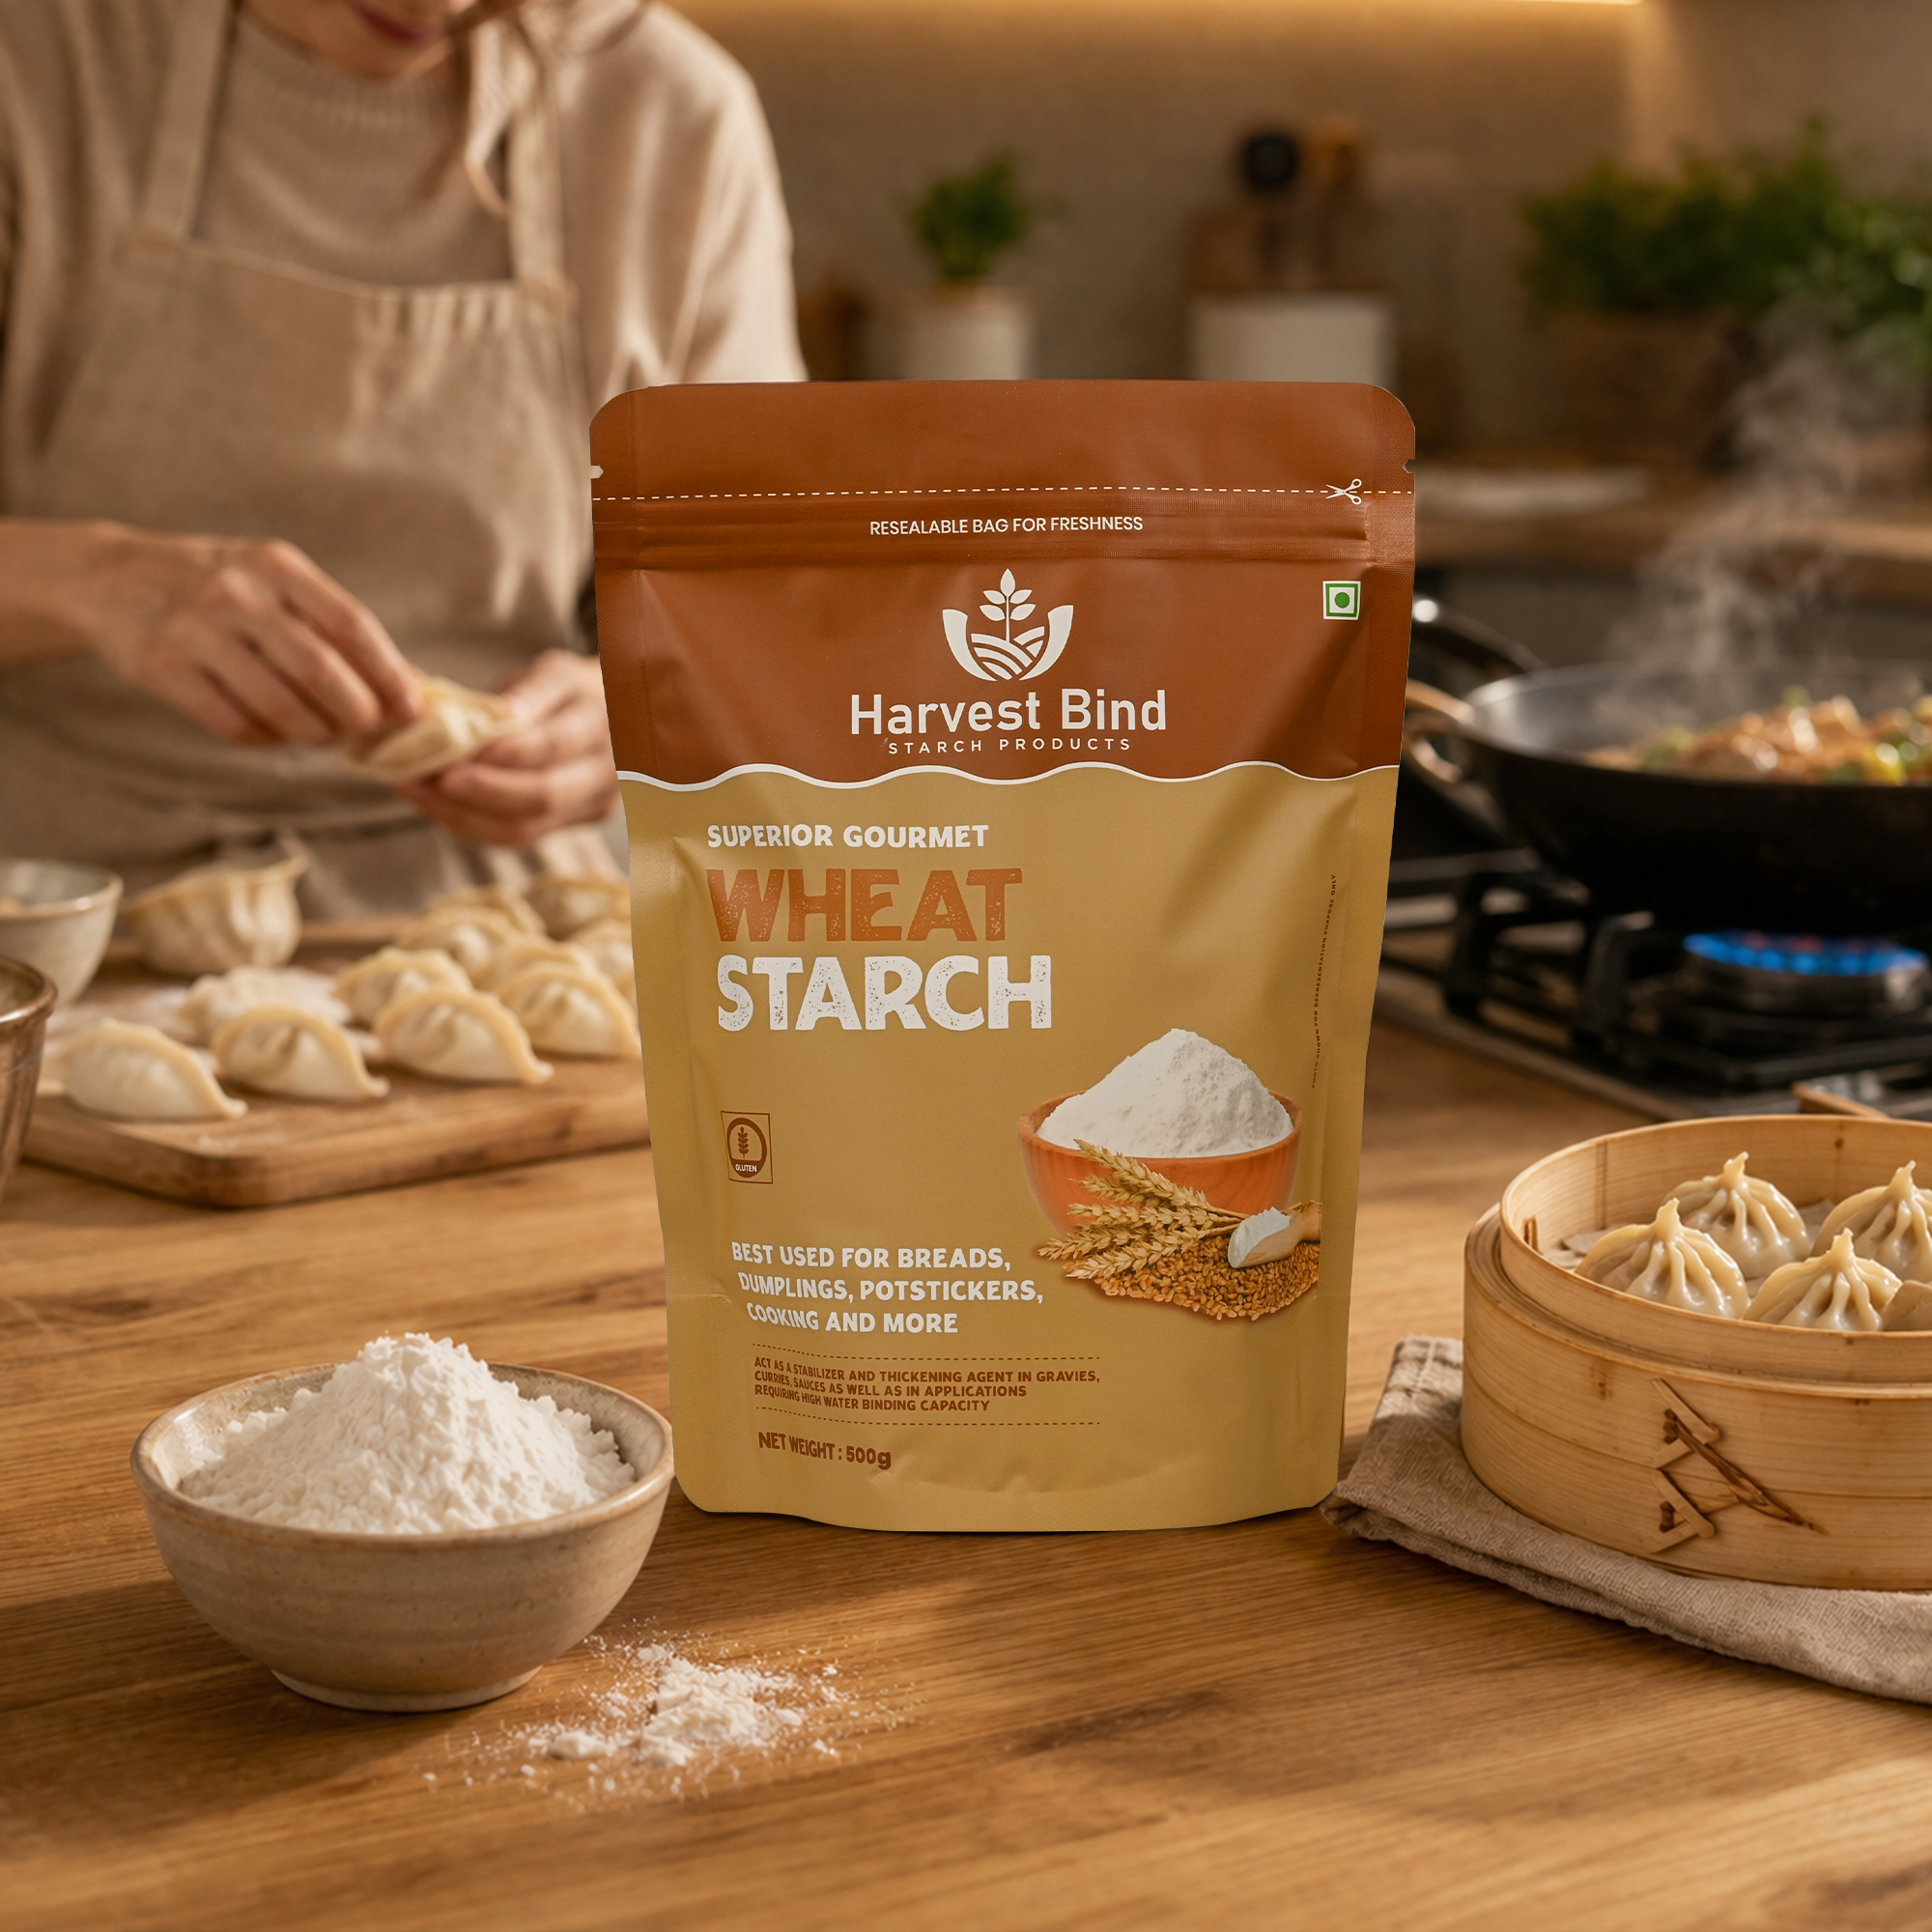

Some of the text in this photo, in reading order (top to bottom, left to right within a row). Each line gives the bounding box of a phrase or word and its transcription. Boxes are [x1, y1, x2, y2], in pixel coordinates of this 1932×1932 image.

[869, 516, 1144, 535] RESEALABLE BAG FOR FRESHNESS
[850, 689, 1167, 735] Harvest Bind
[888, 738, 1131, 755] STARCH PRODUCTS
[707, 824, 988, 848] SUPERIOR GOURMET
[706, 867, 1023, 942] WHEAT
[1314, 937, 1327, 1009] REPRESENTATION
[1323, 898, 1335, 935] PURPOSE
[717, 954, 1052, 1032] STARCH
[735, 1163, 757, 1173] GLUTEN
[731, 1241, 1010, 1271] BEST USED FOR BREADS,
[737, 1271, 1043, 1304] DUMPLINGS, POTSTICKERS,
[747, 1302, 958, 1333] COOKING AND MORE
[754, 1356, 1100, 1383] ACT AS A STABILIZER AND THICKENING AGENT IN GRAVIES,
[754, 1370, 1027, 1397] CURRIES, SAUCES AS WELL AS IN APPLICATIONS
[754, 1384, 990, 1410] REQUIRING HIGH WATER BINDING CAPACITY
[758, 1432, 786, 1450] NET
[788, 1435, 835, 1460] WEIGHT
[846, 1445, 892, 1470] 500g
